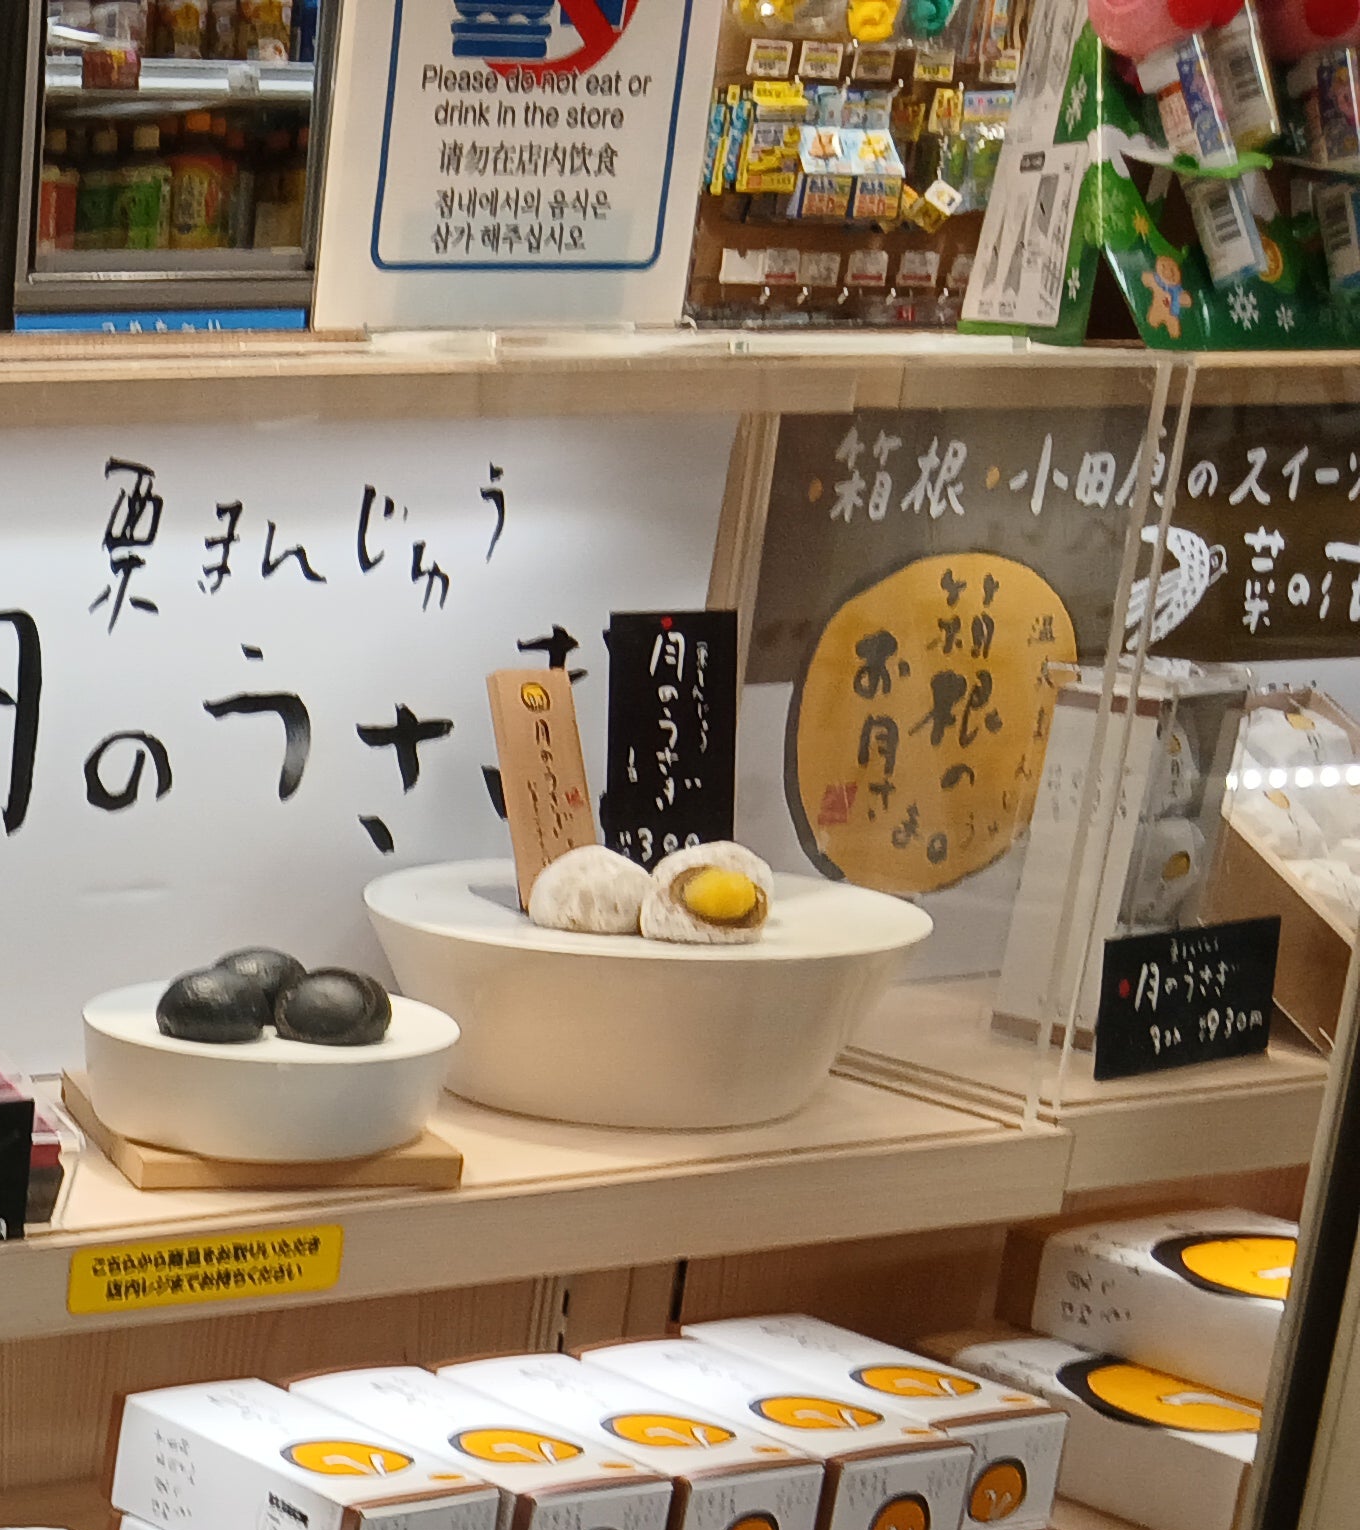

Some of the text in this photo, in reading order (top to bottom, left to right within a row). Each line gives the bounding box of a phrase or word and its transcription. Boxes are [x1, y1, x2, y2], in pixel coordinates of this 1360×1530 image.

[421, 64, 652, 97] Please do not eat or
[434, 100, 625, 129] drink in the store
[439, 139, 618, 177] 请勿在店内饮食
[89, 458, 511, 629] 栗まんじゅう
[909, 566, 1003, 791] 箱根の
[648, 630, 703, 813] 月のうさぎ
[1134, 959, 1240, 1012] 月のうさぎ
